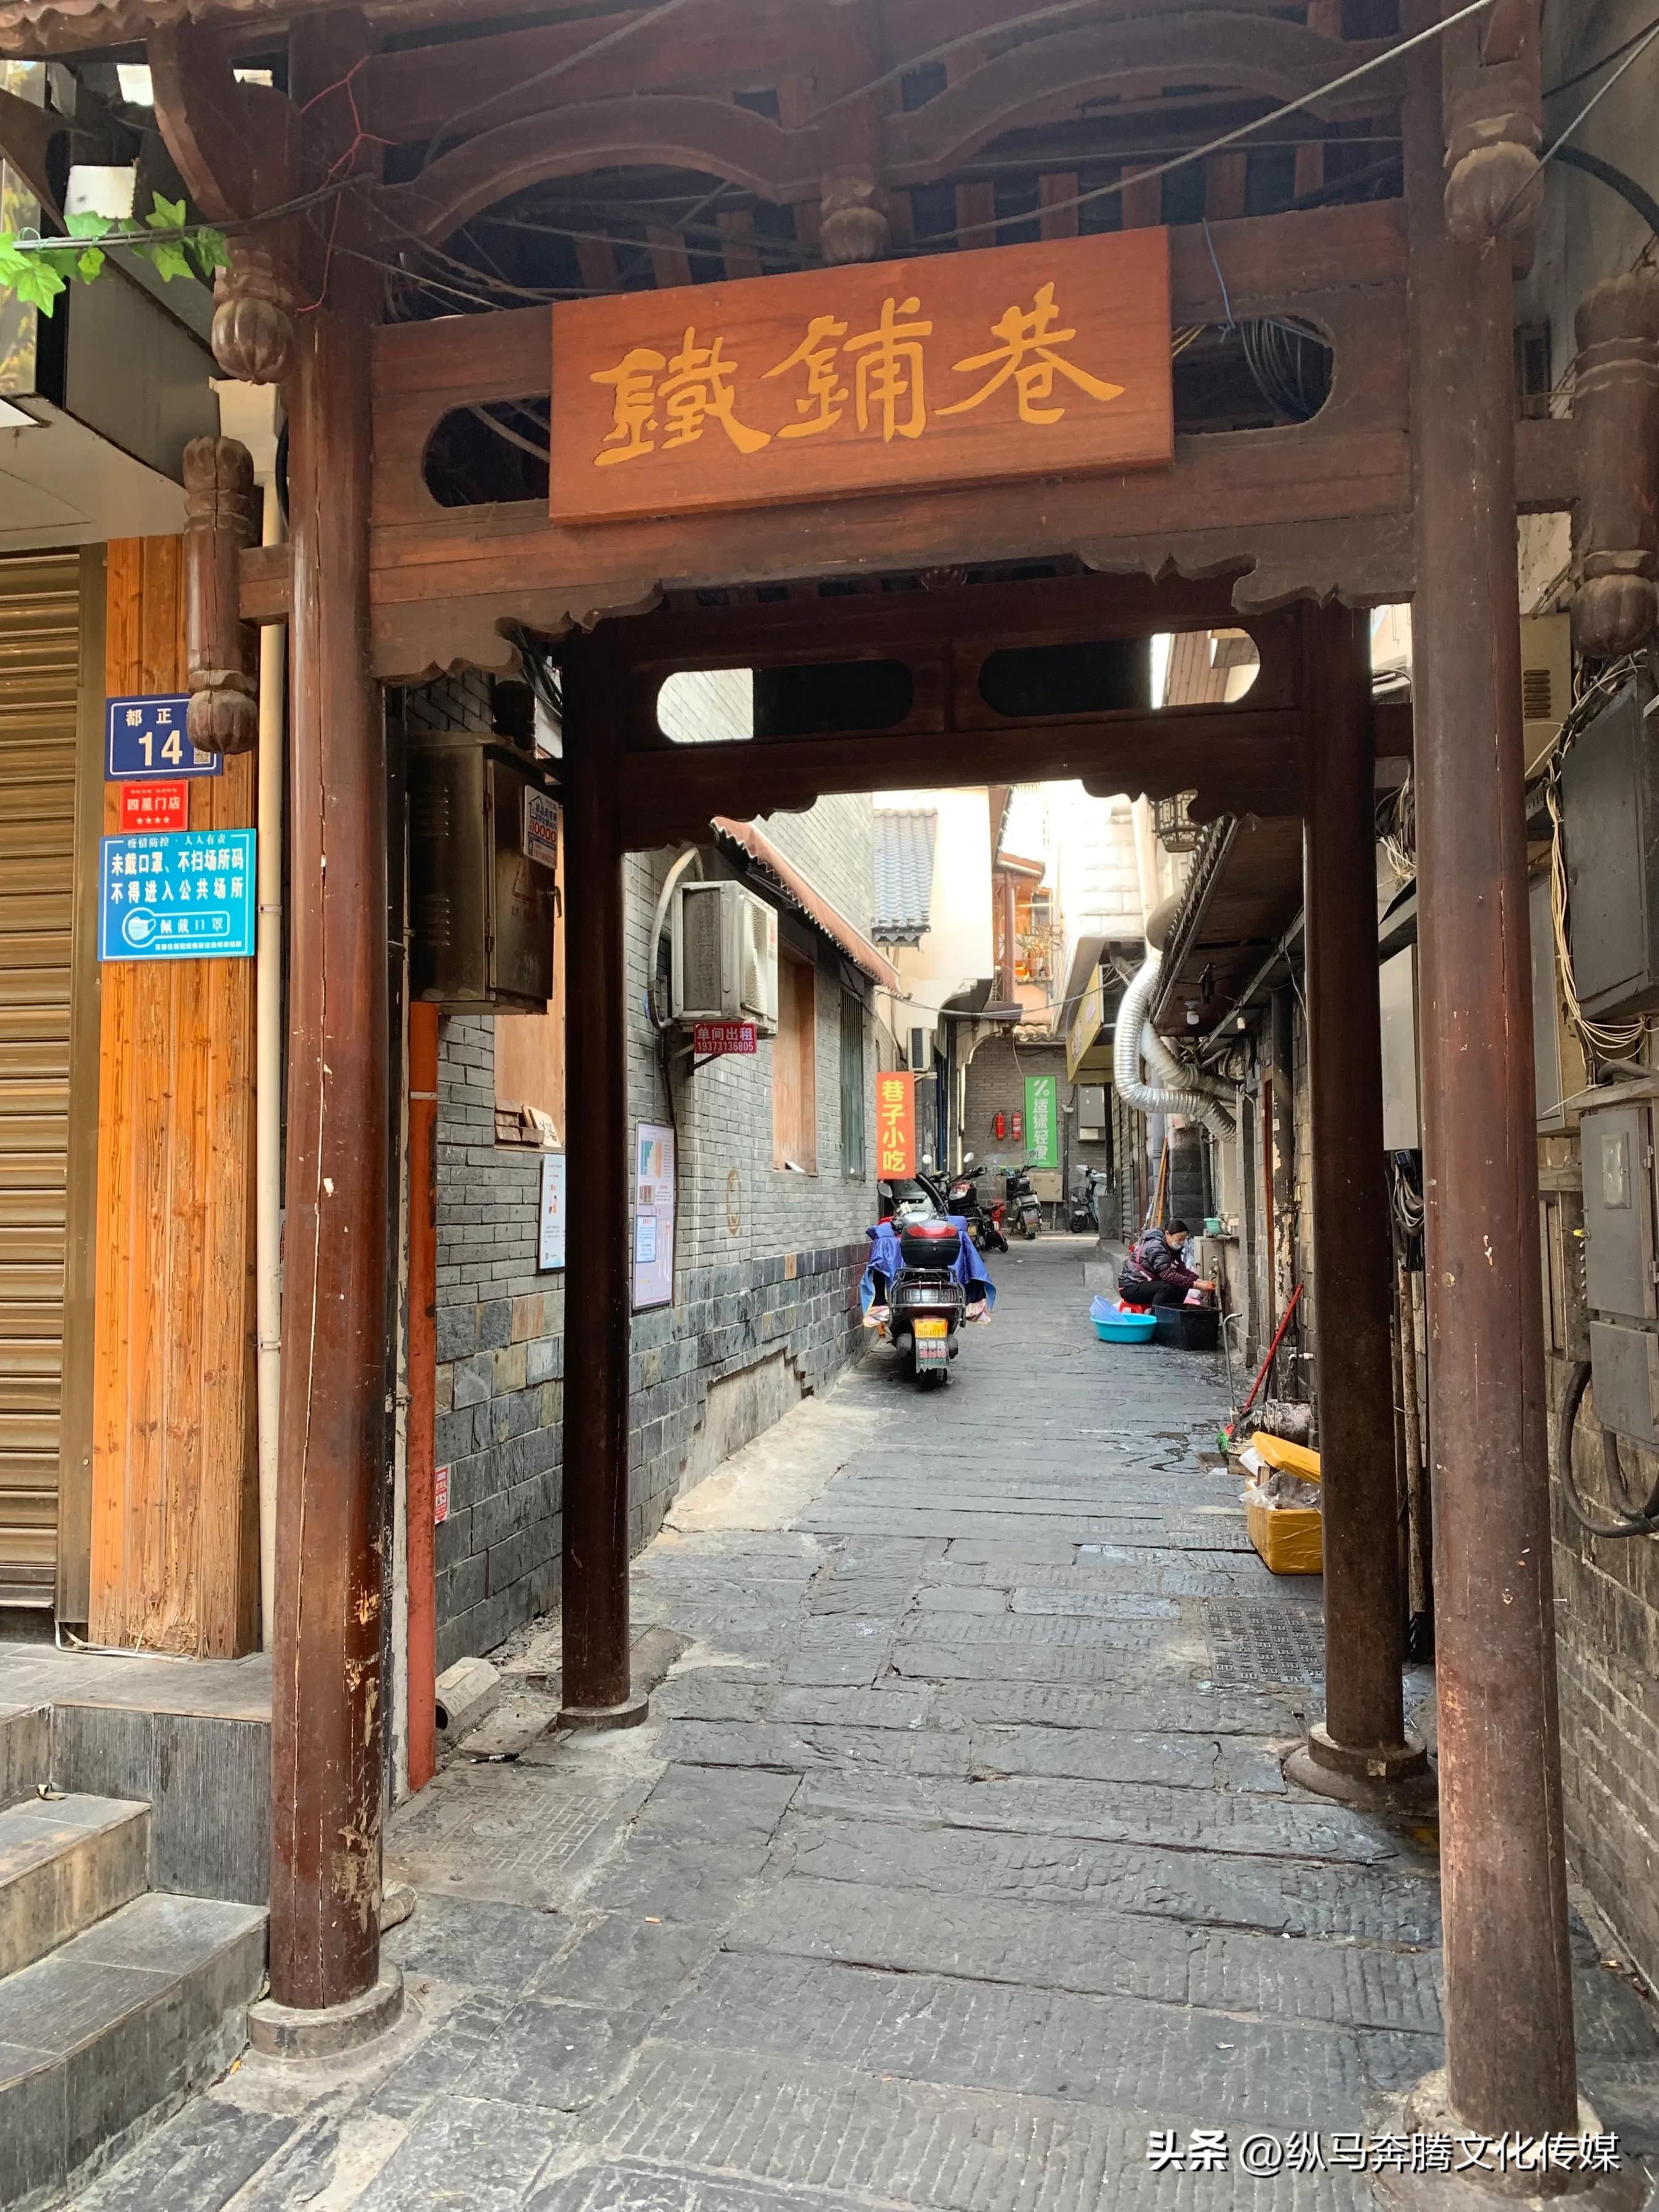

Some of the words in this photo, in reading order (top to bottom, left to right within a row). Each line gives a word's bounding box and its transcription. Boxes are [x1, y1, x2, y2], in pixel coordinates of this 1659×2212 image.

[125, 708, 188, 727] 都正
[138, 730, 182, 766] 14
[127, 796, 181, 811] 四星门店
[111, 847, 244, 876] 未戴口罩、不扫场所码
[111, 876, 244, 904] 不得进入公共场所
[697, 1027, 753, 1041] 单间出租
[697, 1041, 753, 1051] 19373136805
[881, 1080, 906, 1172] 巷子小吃
